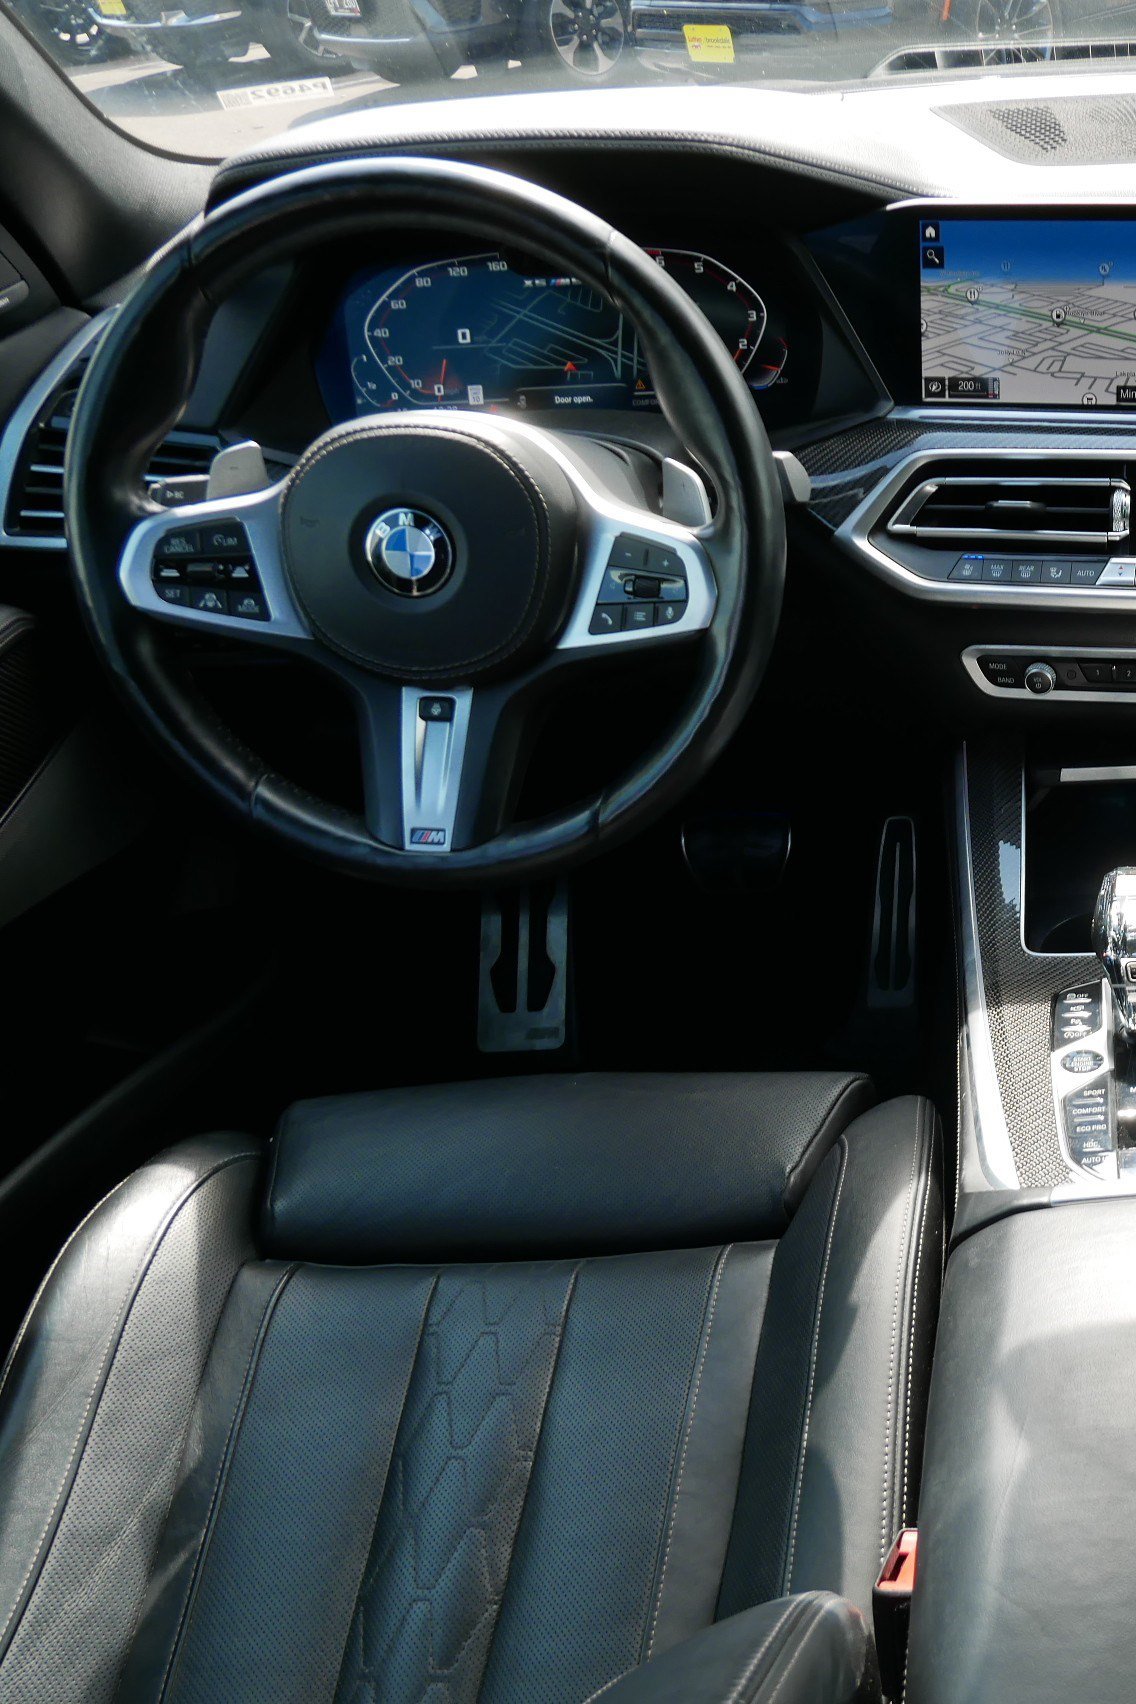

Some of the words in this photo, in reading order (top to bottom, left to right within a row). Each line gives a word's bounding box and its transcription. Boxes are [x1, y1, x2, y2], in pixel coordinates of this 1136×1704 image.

[447, 266, 468, 277] 120
[486, 261, 508, 272] 160
[694, 261, 704, 274] 5
[415, 277, 432, 288] 80
[726, 281, 737, 293] 4
[390, 299, 407, 310] 60
[747, 310, 757, 322] 3
[373, 328, 390, 339] 40
[457, 327, 471, 344] 0
[738, 338, 748, 350] 2
[387, 355, 404, 366] 20
[409, 379, 423, 389] 10
[433, 383, 444, 396] 0
[958, 380, 975, 391] 200
[554, 395, 572, 404] Door
[573, 395, 594, 405] open.
[373, 511, 444, 543] BMW
[988, 662, 1008, 670] MODE
[1083, 1089, 1106, 1097] SPORT
[1072, 1107, 1106, 1115] COMFORT
[1076, 1125, 1091, 1133] ECO
